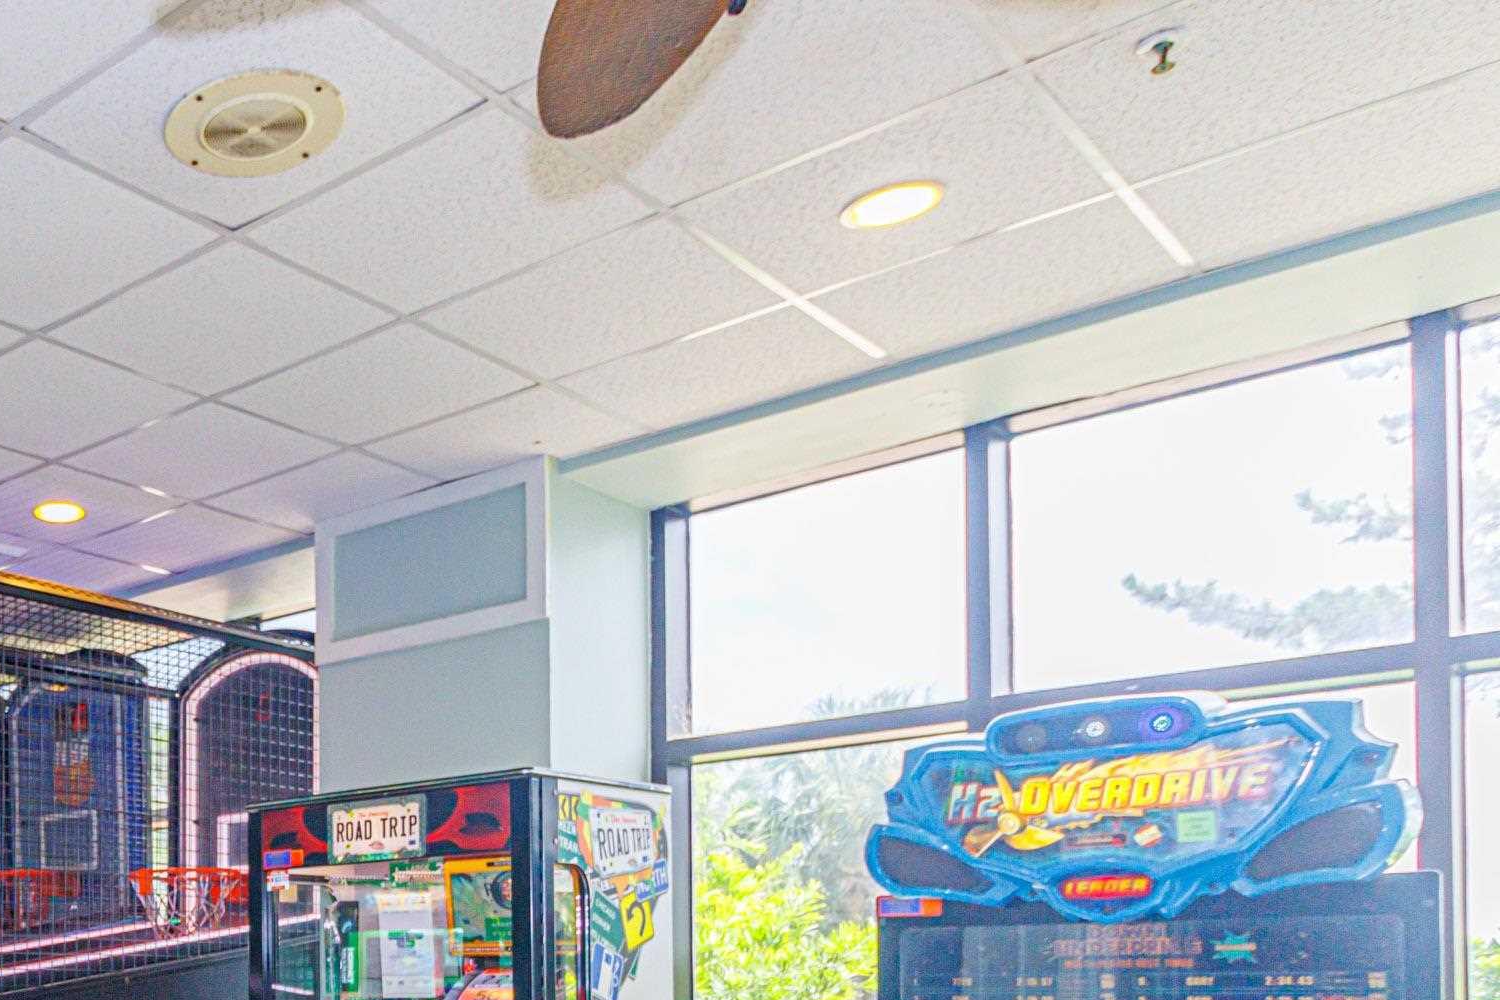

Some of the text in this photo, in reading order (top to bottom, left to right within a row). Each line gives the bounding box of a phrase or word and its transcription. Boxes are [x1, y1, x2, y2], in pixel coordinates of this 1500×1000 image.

[1020, 762, 1272, 818] OVERDRIVE
[336, 814, 417, 843] ROAD TRIP
[598, 828, 629, 860] ROAD
[630, 828, 650, 850] TRIP
[1063, 878, 1151, 899] LEADER
